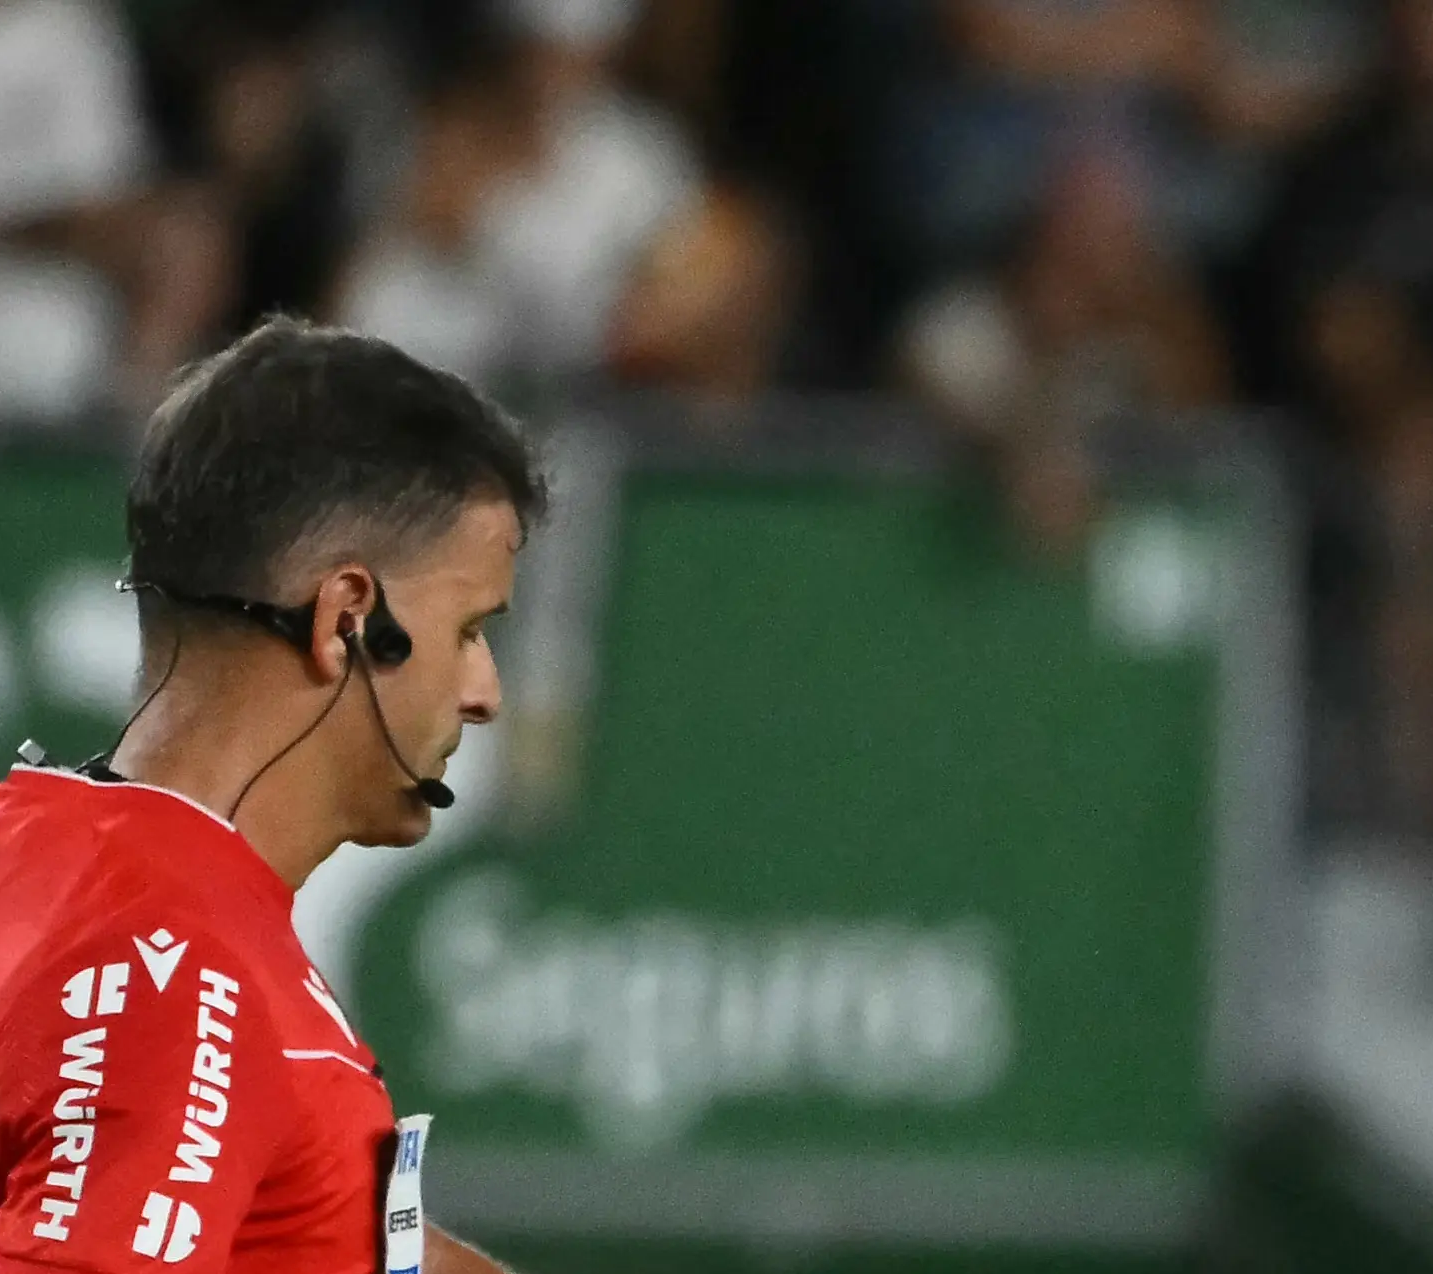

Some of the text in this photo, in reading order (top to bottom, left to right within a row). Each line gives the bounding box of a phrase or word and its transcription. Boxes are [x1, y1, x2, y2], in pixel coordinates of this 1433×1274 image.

[167, 967, 240, 1183] WÜRTH
[415, 875, 1012, 1150] Seguros
[32, 1026, 108, 1242] WÜRTH
